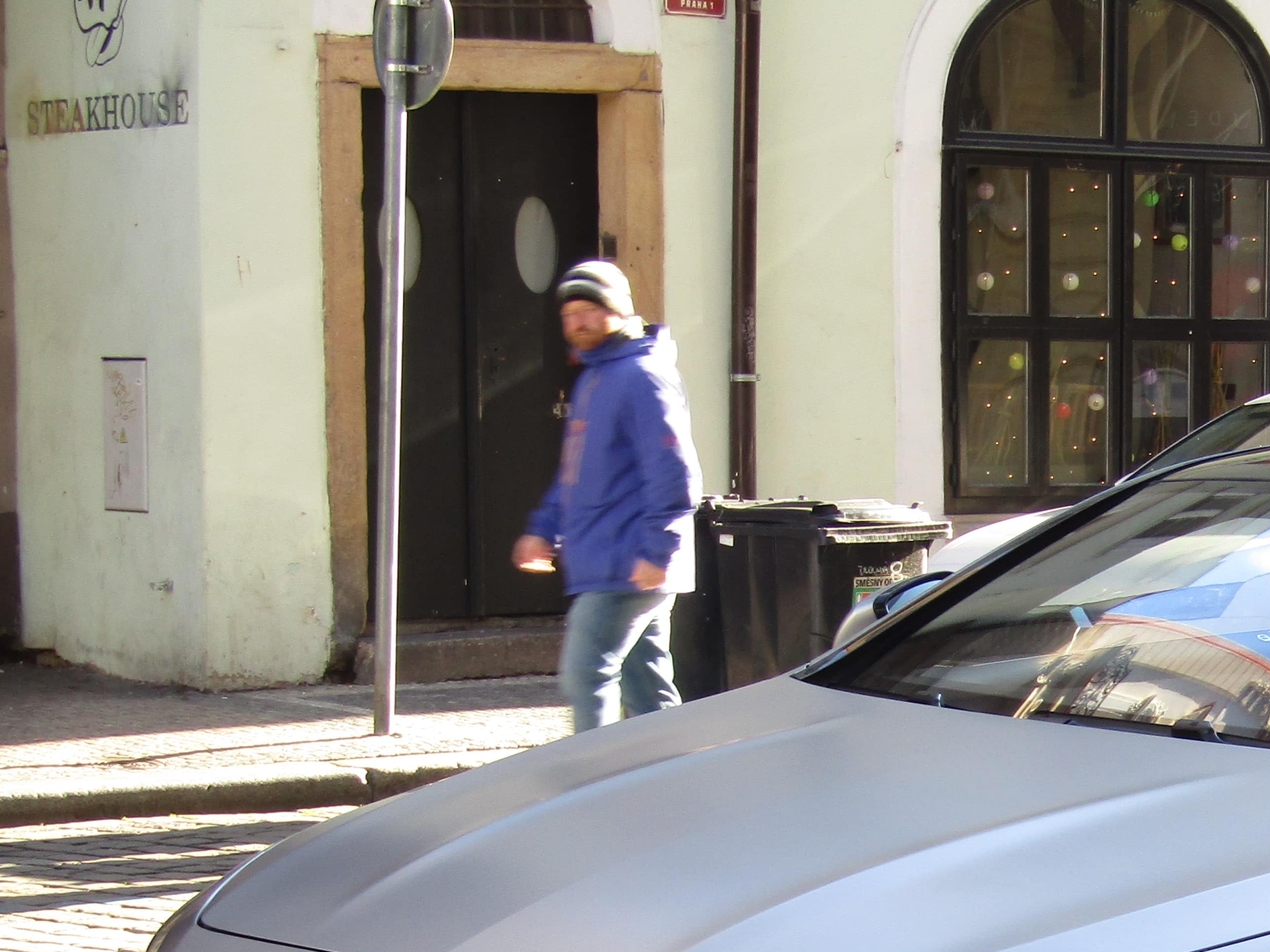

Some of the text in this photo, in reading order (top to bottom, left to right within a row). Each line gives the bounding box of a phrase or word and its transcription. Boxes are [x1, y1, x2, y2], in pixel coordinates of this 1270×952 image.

[680, 0, 708, 9] PRAHA
[27, 89, 189, 136] STEAKHOUSE
[890, 561, 904, 582] 8
